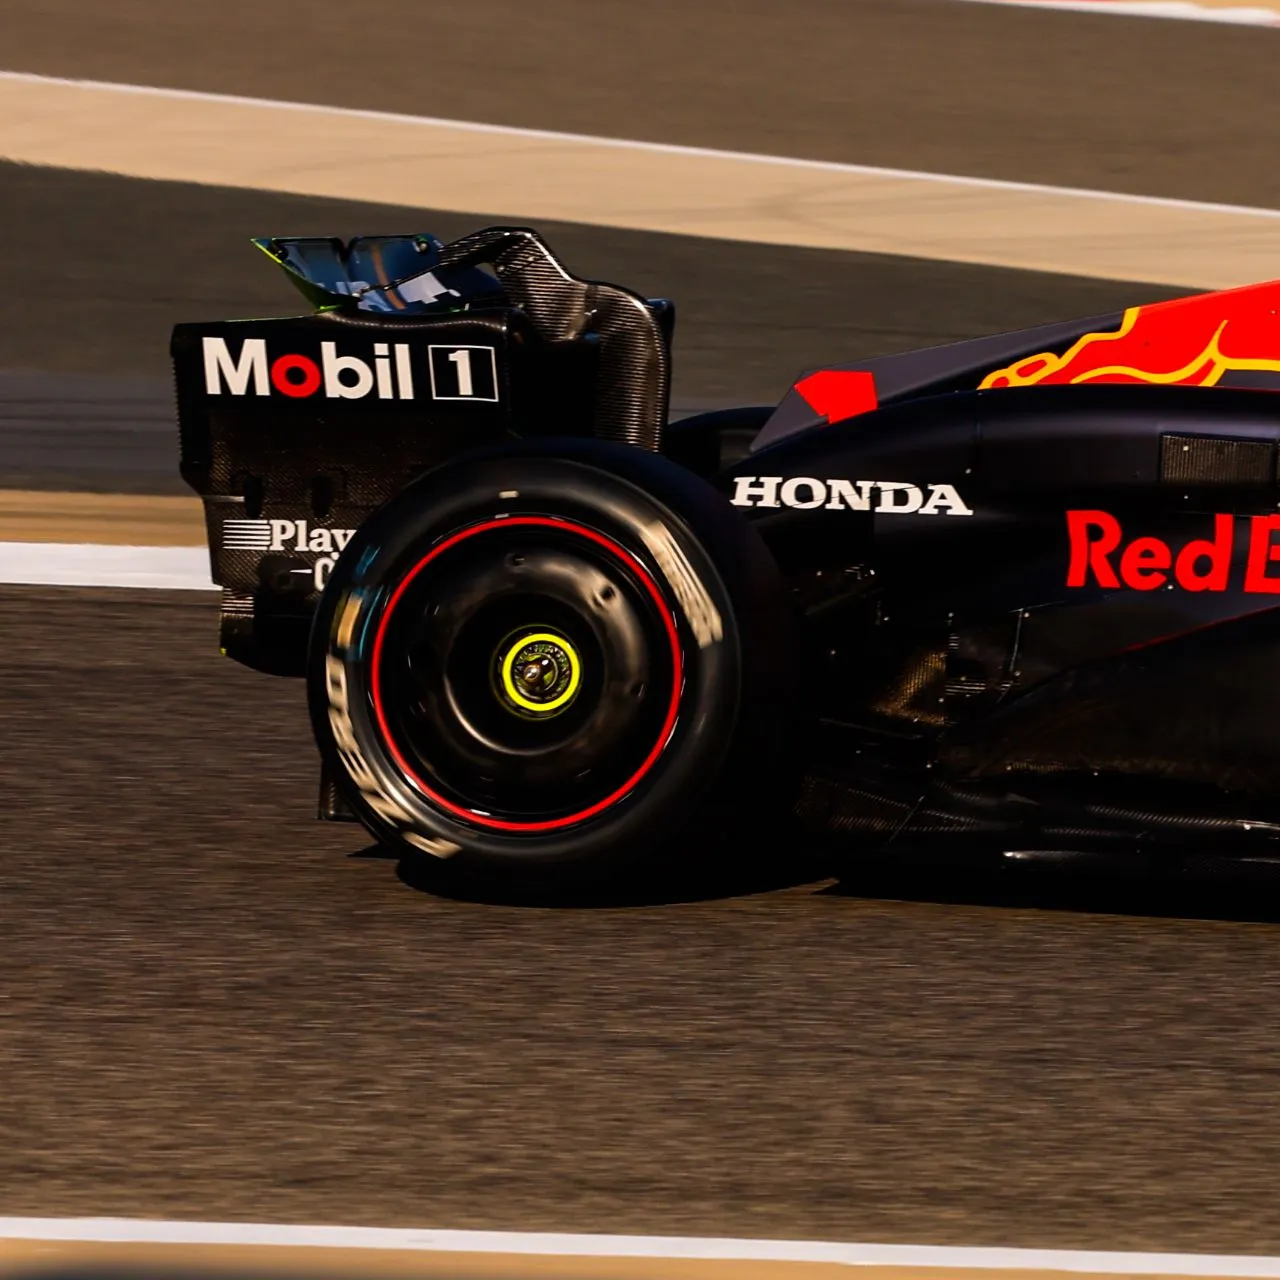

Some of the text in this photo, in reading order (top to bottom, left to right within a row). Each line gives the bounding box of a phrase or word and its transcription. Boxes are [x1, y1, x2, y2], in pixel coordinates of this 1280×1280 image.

[202, 337, 473, 400] Mobil 1
[730, 476, 974, 516] HONDA
[1065, 510, 1236, 593] Red
